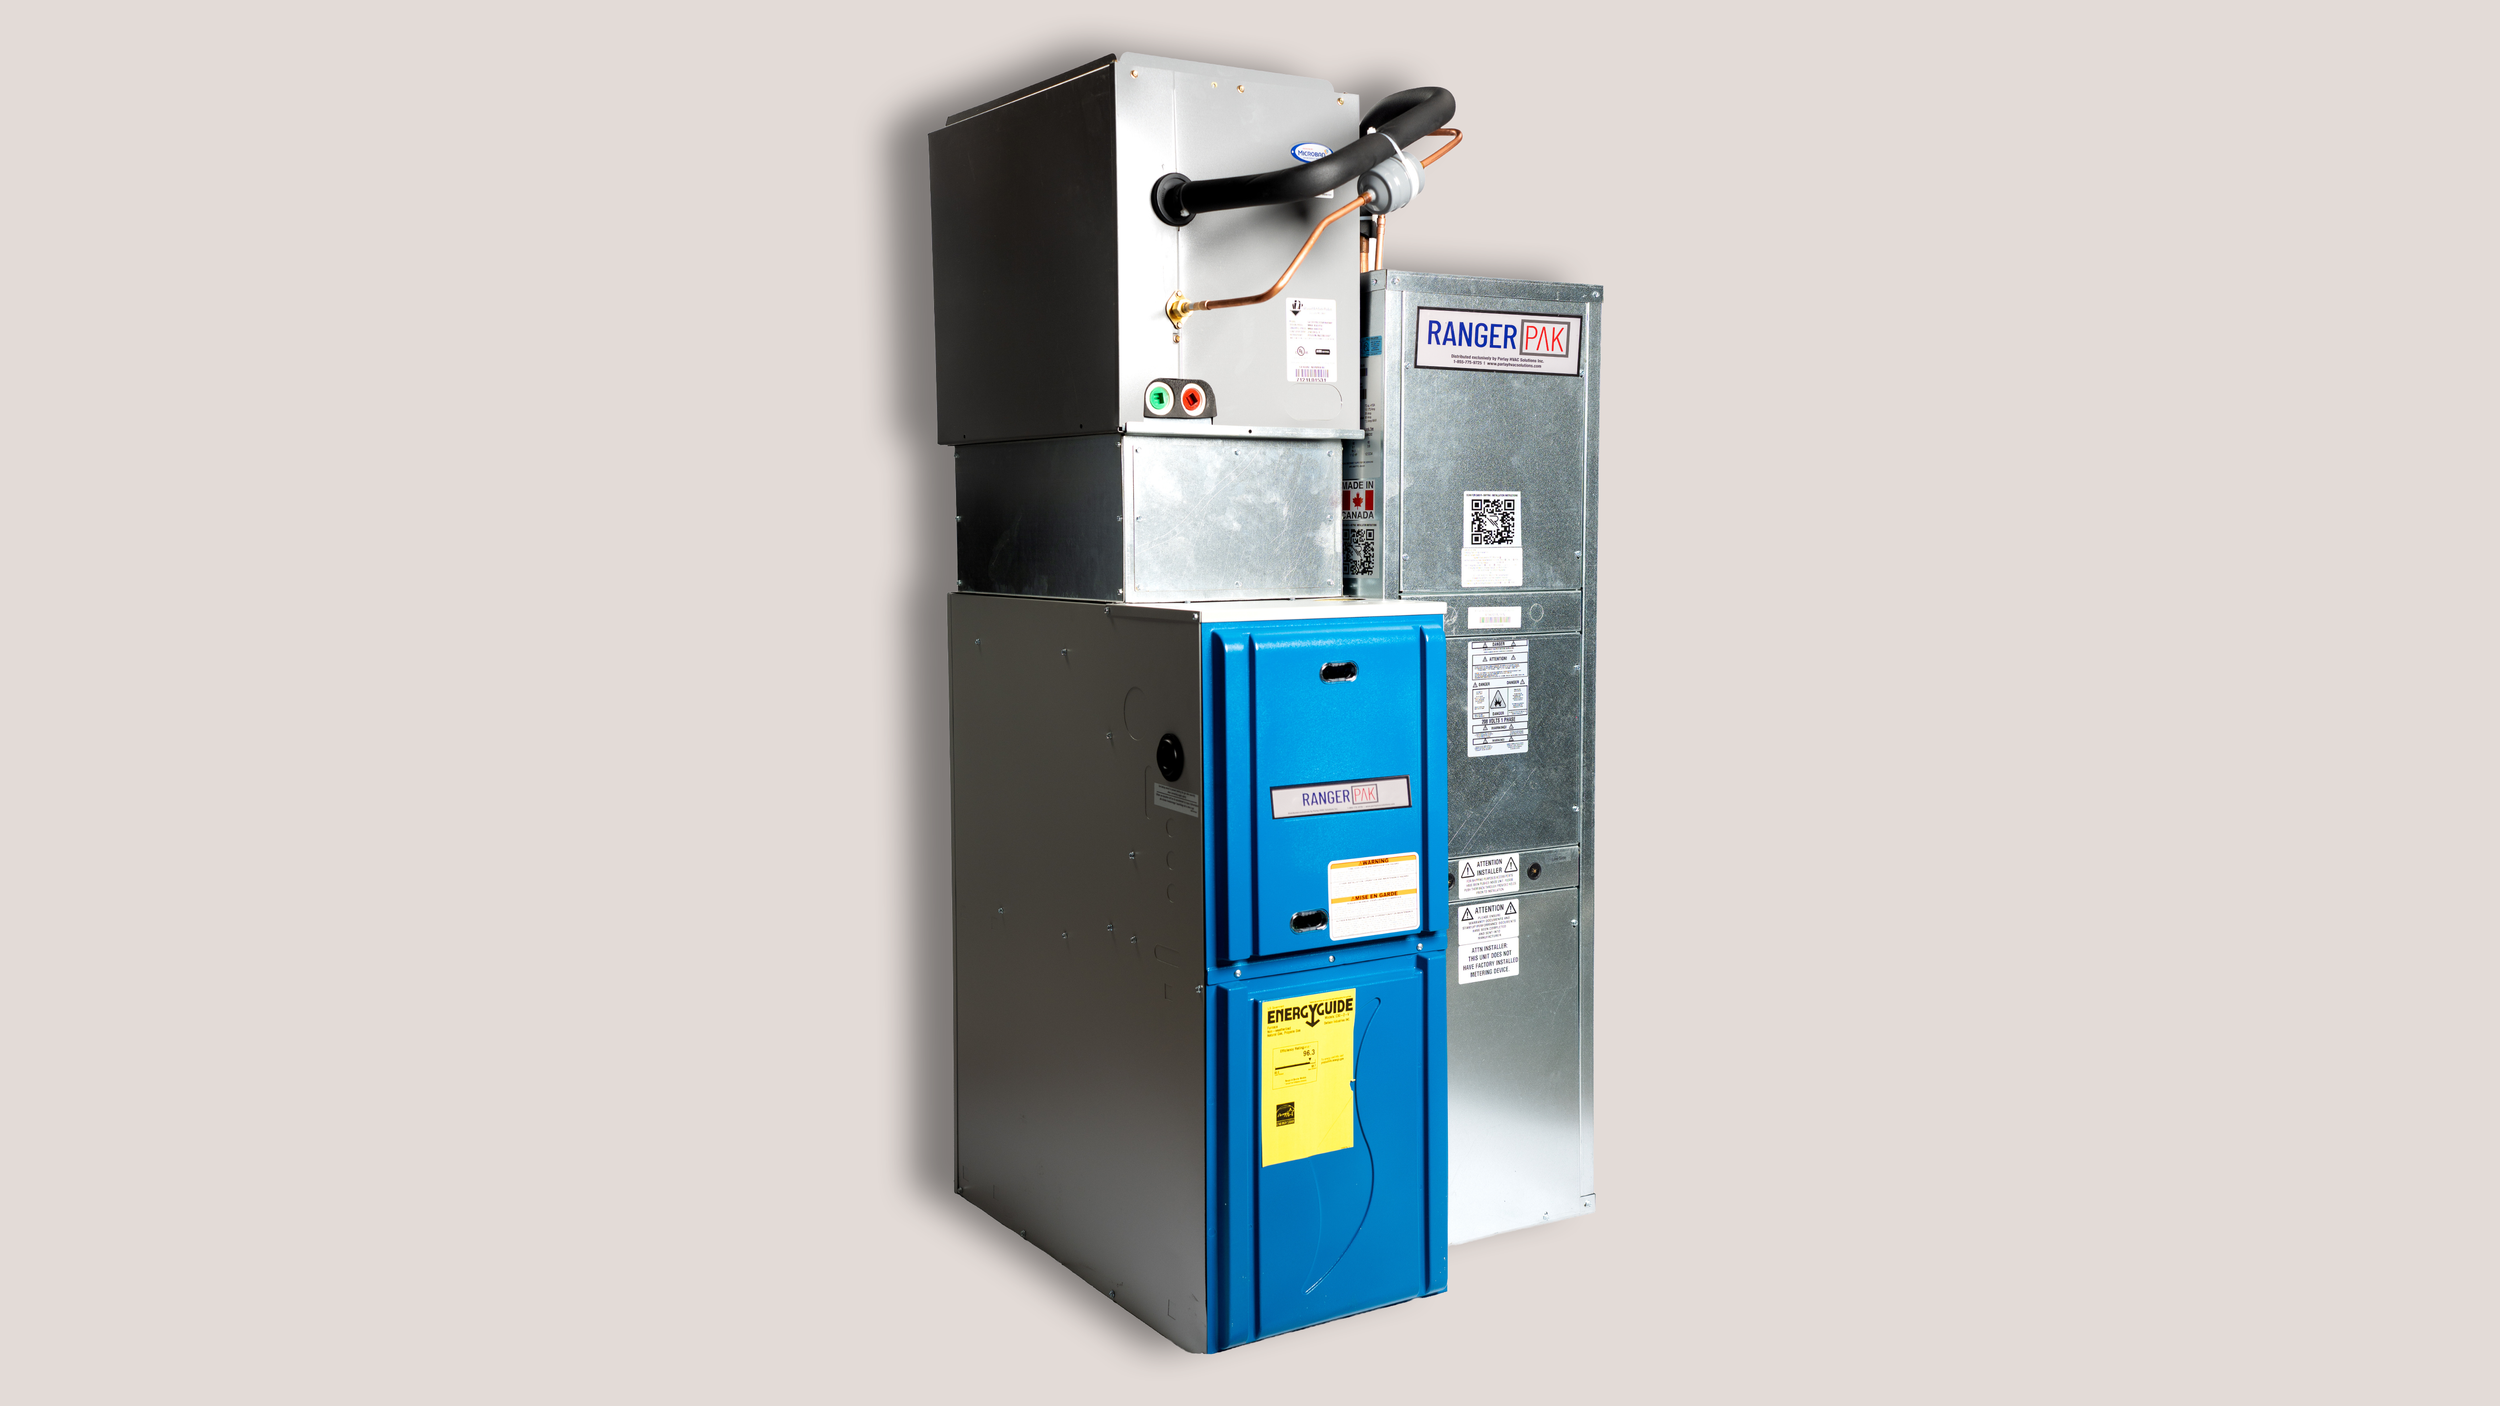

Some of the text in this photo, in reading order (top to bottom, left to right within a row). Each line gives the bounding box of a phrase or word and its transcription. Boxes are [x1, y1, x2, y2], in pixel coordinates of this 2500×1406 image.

[1428, 320, 1564, 352] RANGER PAK
[1342, 481, 1374, 490] MADE IN
[1342, 511, 1374, 520] CANADA
[1302, 786, 1376, 806] RANGER PAK
[1477, 858, 1502, 867] ATTENTION
[1477, 867, 1502, 876] INSTALLER
[1475, 904, 1504, 914] ATTENTION
[1484, 943, 1508, 951] INSTALLER:
[1476, 960, 1495, 969] FACTORY
[1496, 957, 1518, 966] INSTALLED
[1470, 969, 1492, 978] METERING
[1267, 998, 1353, 1027] ENERGYGUIDE
